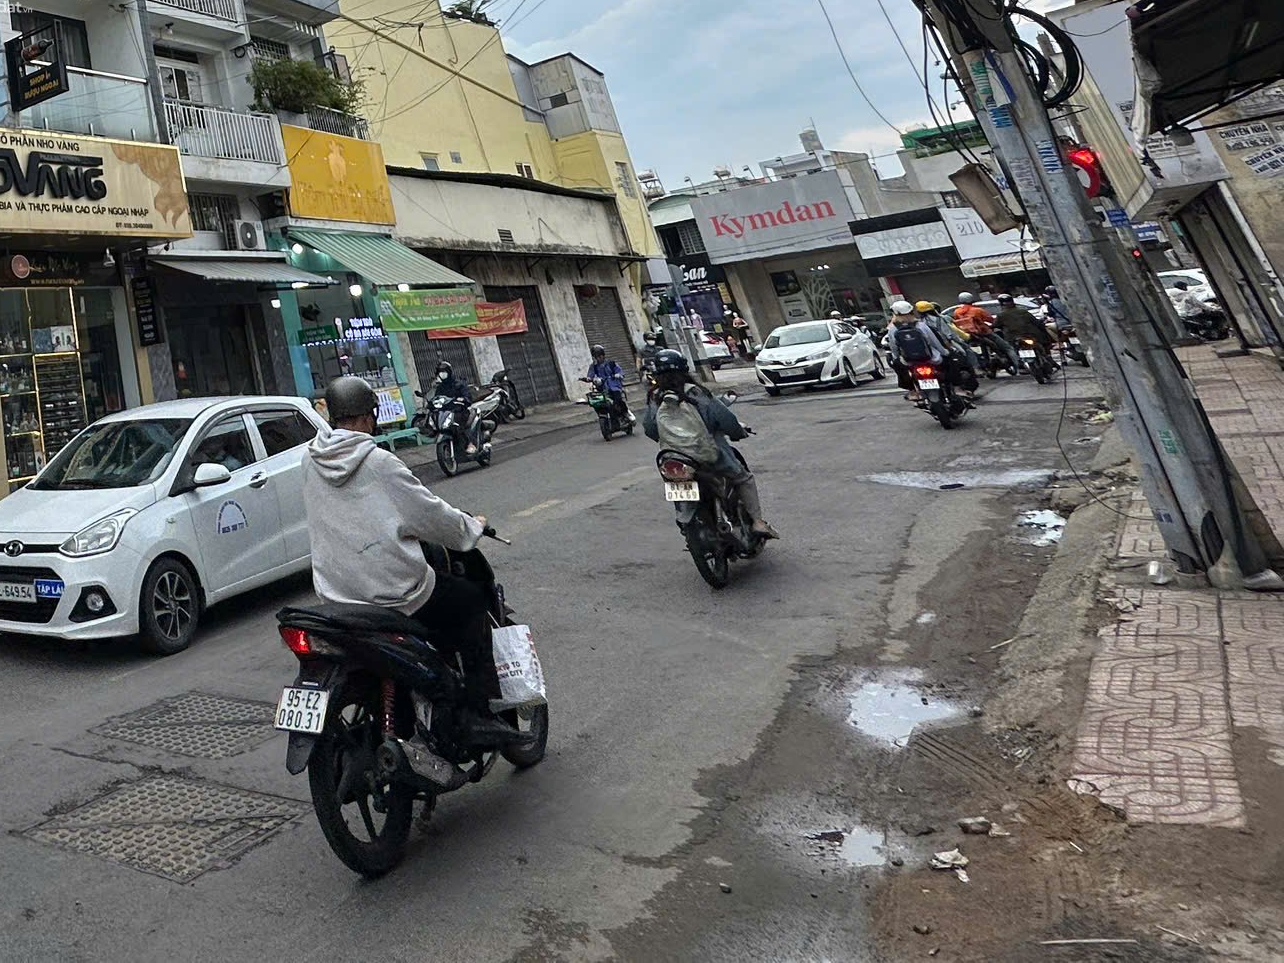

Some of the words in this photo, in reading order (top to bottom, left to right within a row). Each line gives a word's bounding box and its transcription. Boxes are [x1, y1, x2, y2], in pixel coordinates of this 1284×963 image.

[36, 139, 55, 149] NHO
[56, 139, 80, 152] VÀNG
[0, 199, 13, 210] BIA
[15, 201, 27, 211] VÀ
[28, 202, 50, 214] THỰC
[75, 205, 90, 214] CAO
[709, 199, 837, 238] Kymdan
[509, 669, 523, 677] CITY
[278, 708, 321, 731] 080.31
